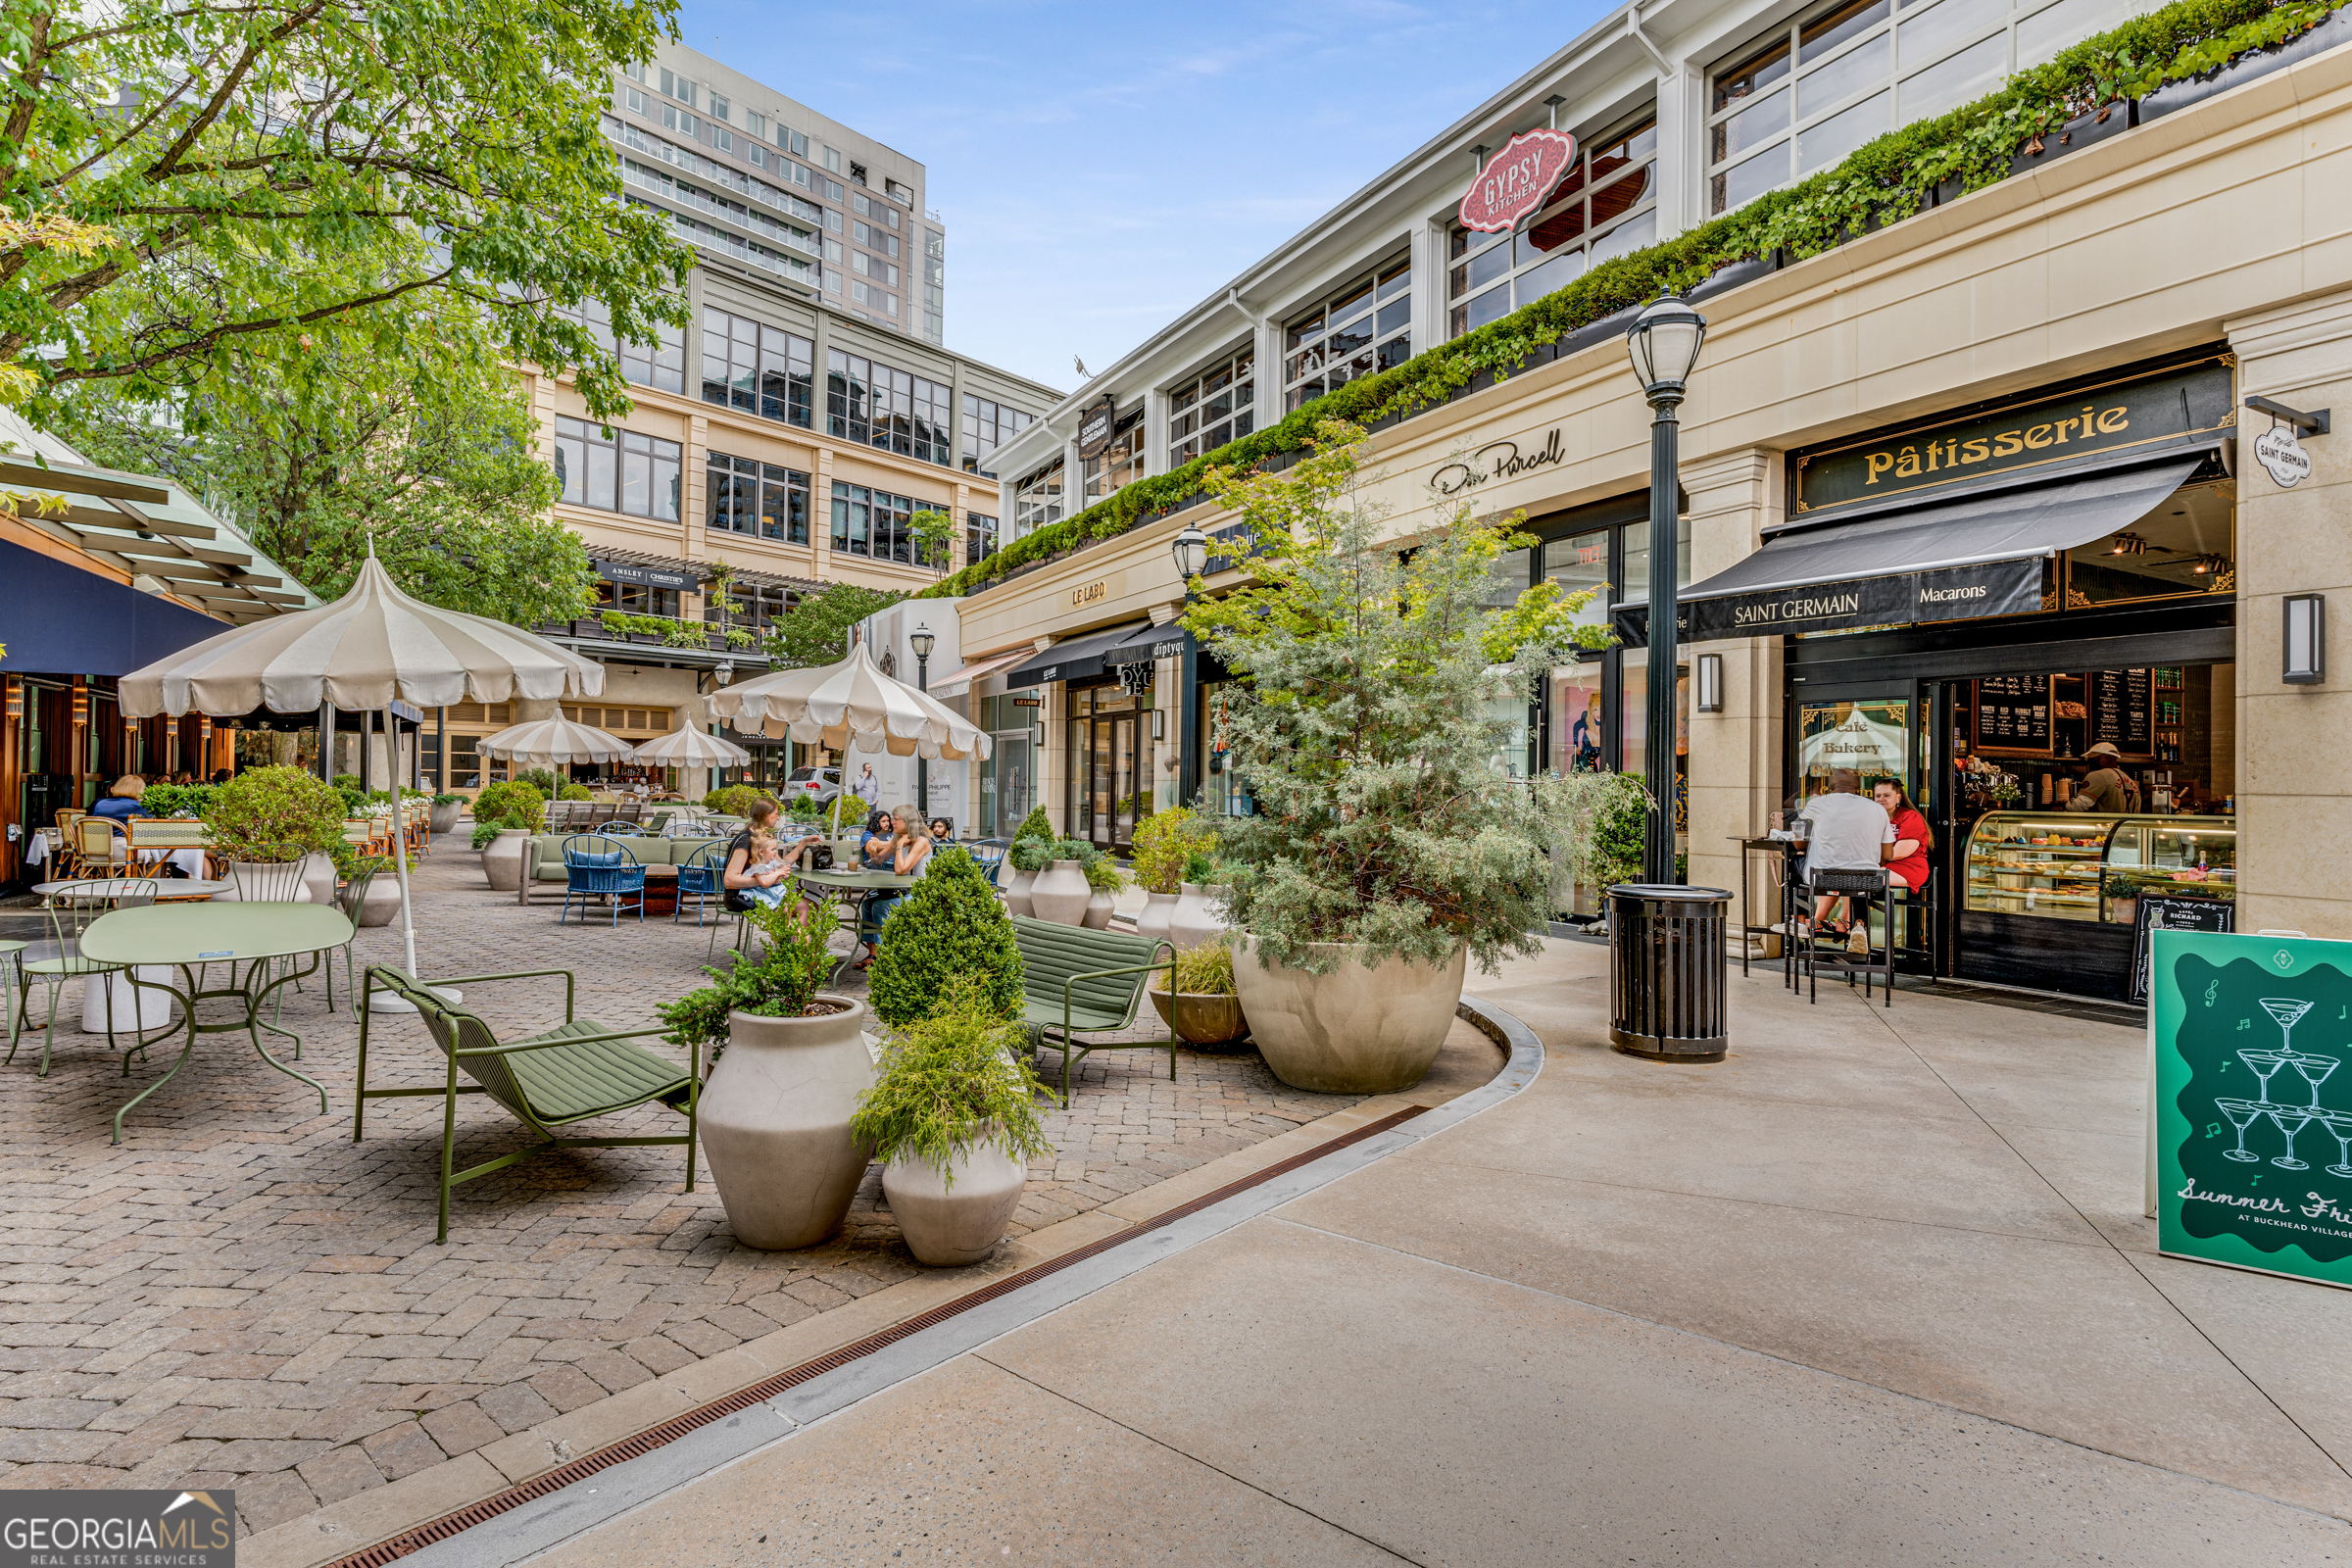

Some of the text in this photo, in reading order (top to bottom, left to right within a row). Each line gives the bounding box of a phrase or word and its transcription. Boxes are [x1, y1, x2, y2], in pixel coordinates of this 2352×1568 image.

[1485, 147, 1543, 206] GYPSY
[1489, 180, 1538, 217] KITCHEN
[1081, 424, 1107, 448] GENTLEMAN
[1082, 415, 1106, 437] SOUTHERN
[1475, 428, 1566, 477] Purcell
[1864, 406, 2129, 485] Pâtisserie
[2261, 444, 2308, 469] SAINT GERMAIN
[612, 567, 642, 577] ANSLEY
[650, 573, 683, 583] CHRISTIE'S
[1072, 581, 1105, 606] LE LABO
[1920, 584, 1986, 604] Macarons
[1735, 593, 1859, 624] SAINT GERMAIN
[1153, 641, 1184, 658] diptyqu
[1048, 666, 1057, 675] LABO
[1835, 721, 1868, 733] Café
[1824, 743, 1882, 756] Bakery
[2170, 912, 2202, 921] RICHARD
[2178, 1177, 2291, 1214] Summer
[2254, 1216, 2308, 1231] BUCKHEAD
[2311, 1225, 2352, 1240] VILLAGE
